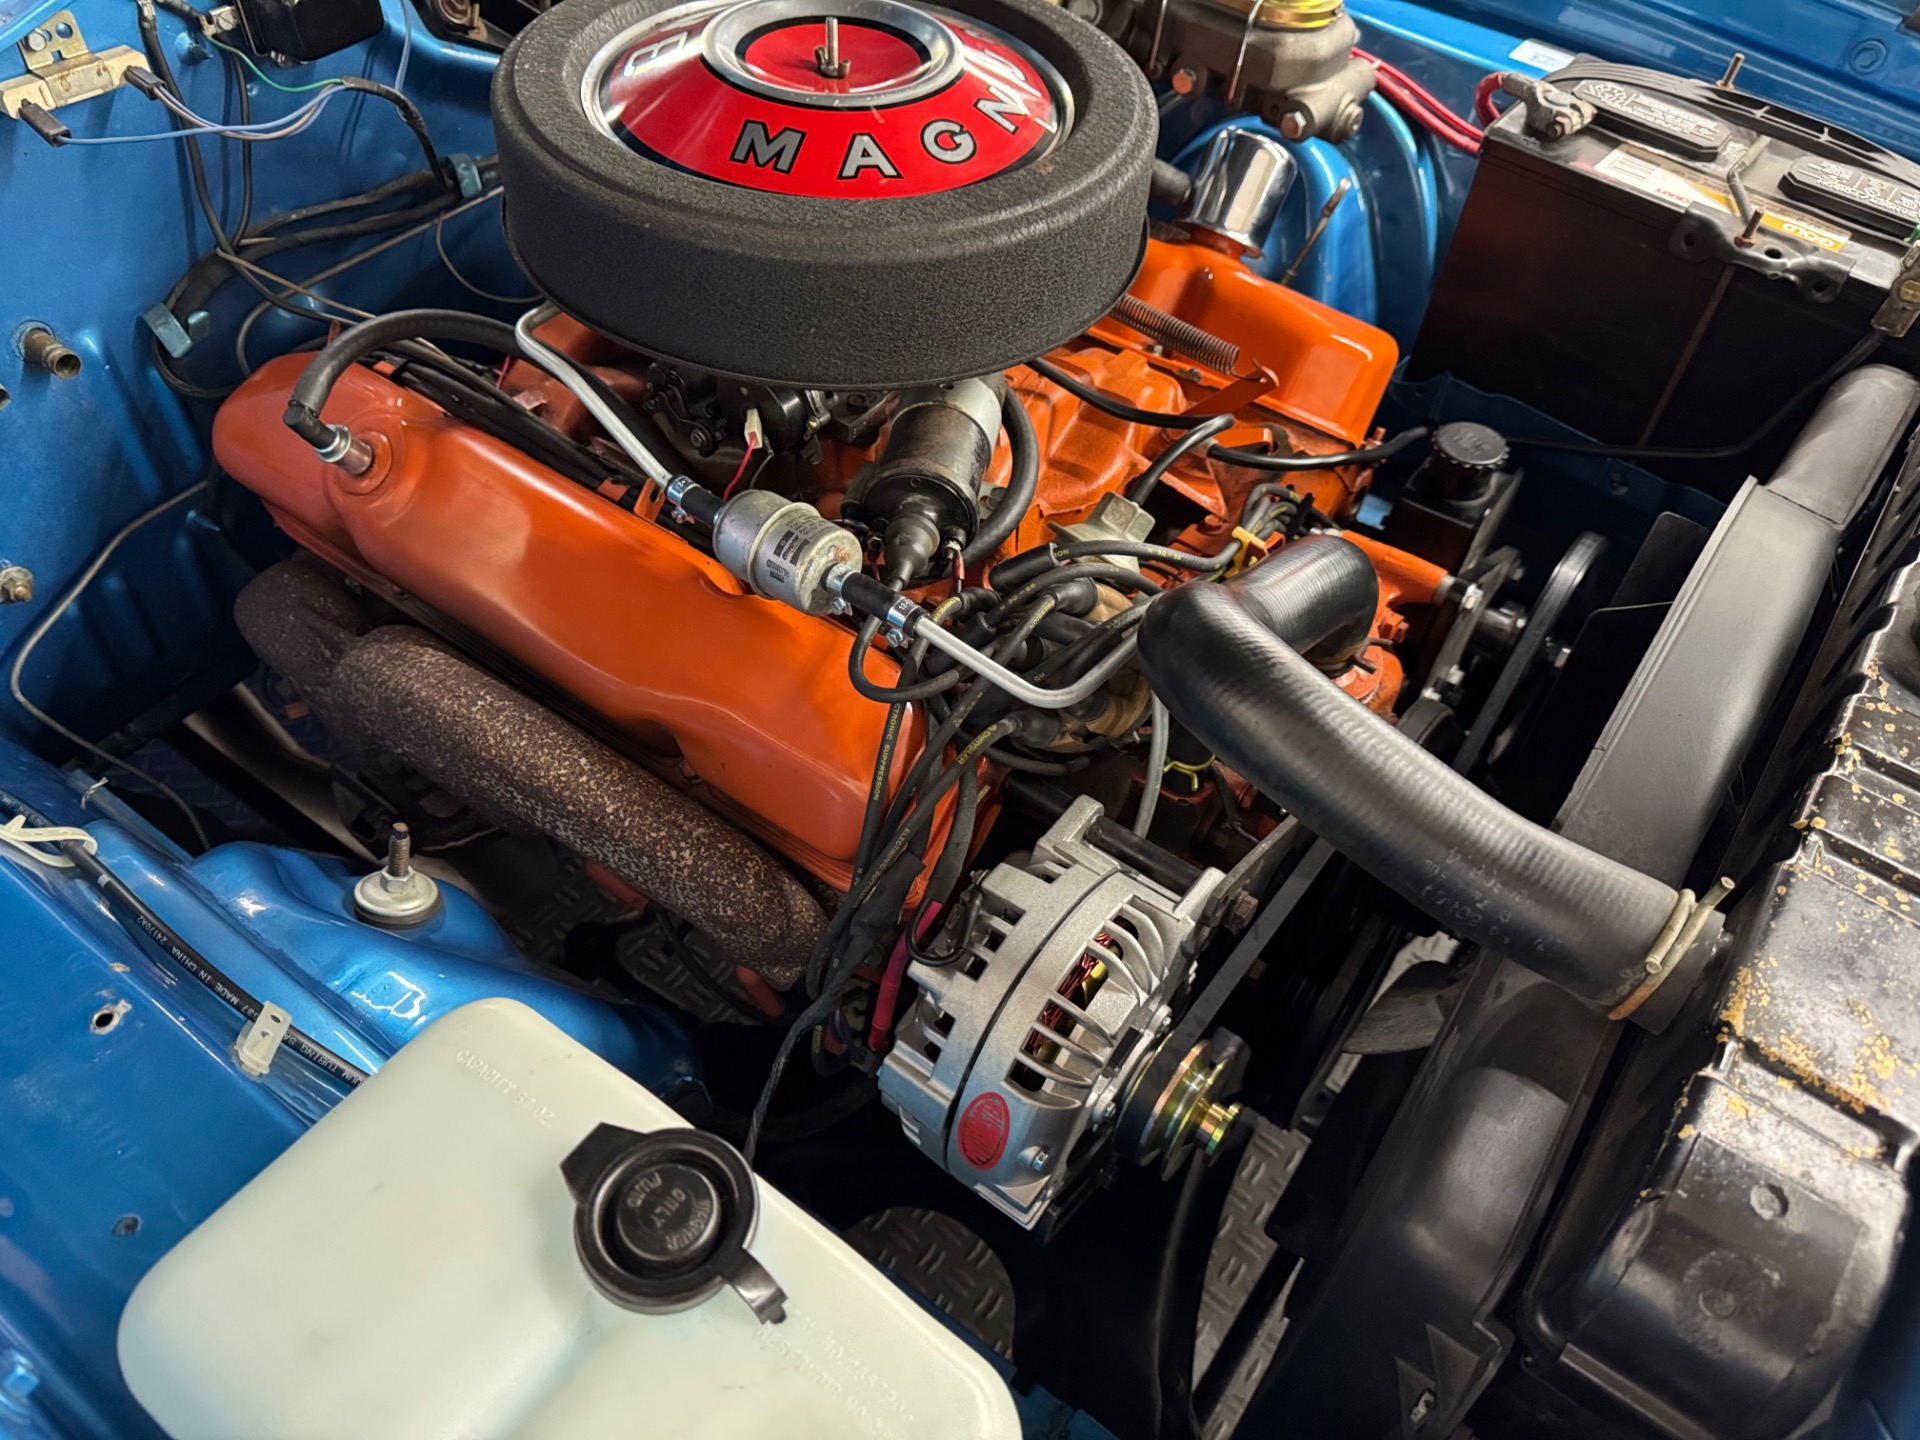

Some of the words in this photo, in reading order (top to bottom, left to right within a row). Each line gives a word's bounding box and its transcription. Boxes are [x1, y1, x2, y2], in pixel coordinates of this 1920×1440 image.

[1655, 187, 1692, 206] CRAFT
[1782, 221, 1836, 250] GOLD
[885, 702, 902, 748] CTRONIC
[956, 730, 993, 766] CHRYSLER
[872, 744, 891, 801] SUPPRESSION
[880, 827, 911, 871] ELECTRONIC
[172, 945, 198, 974] CHINA
[198, 966, 211, 982] IN
[214, 981, 240, 1005] MADE
[281, 1024, 297, 1046] SA
[299, 1042, 340, 1075] TUBING
[456, 1049, 517, 1096] CAPACITY
